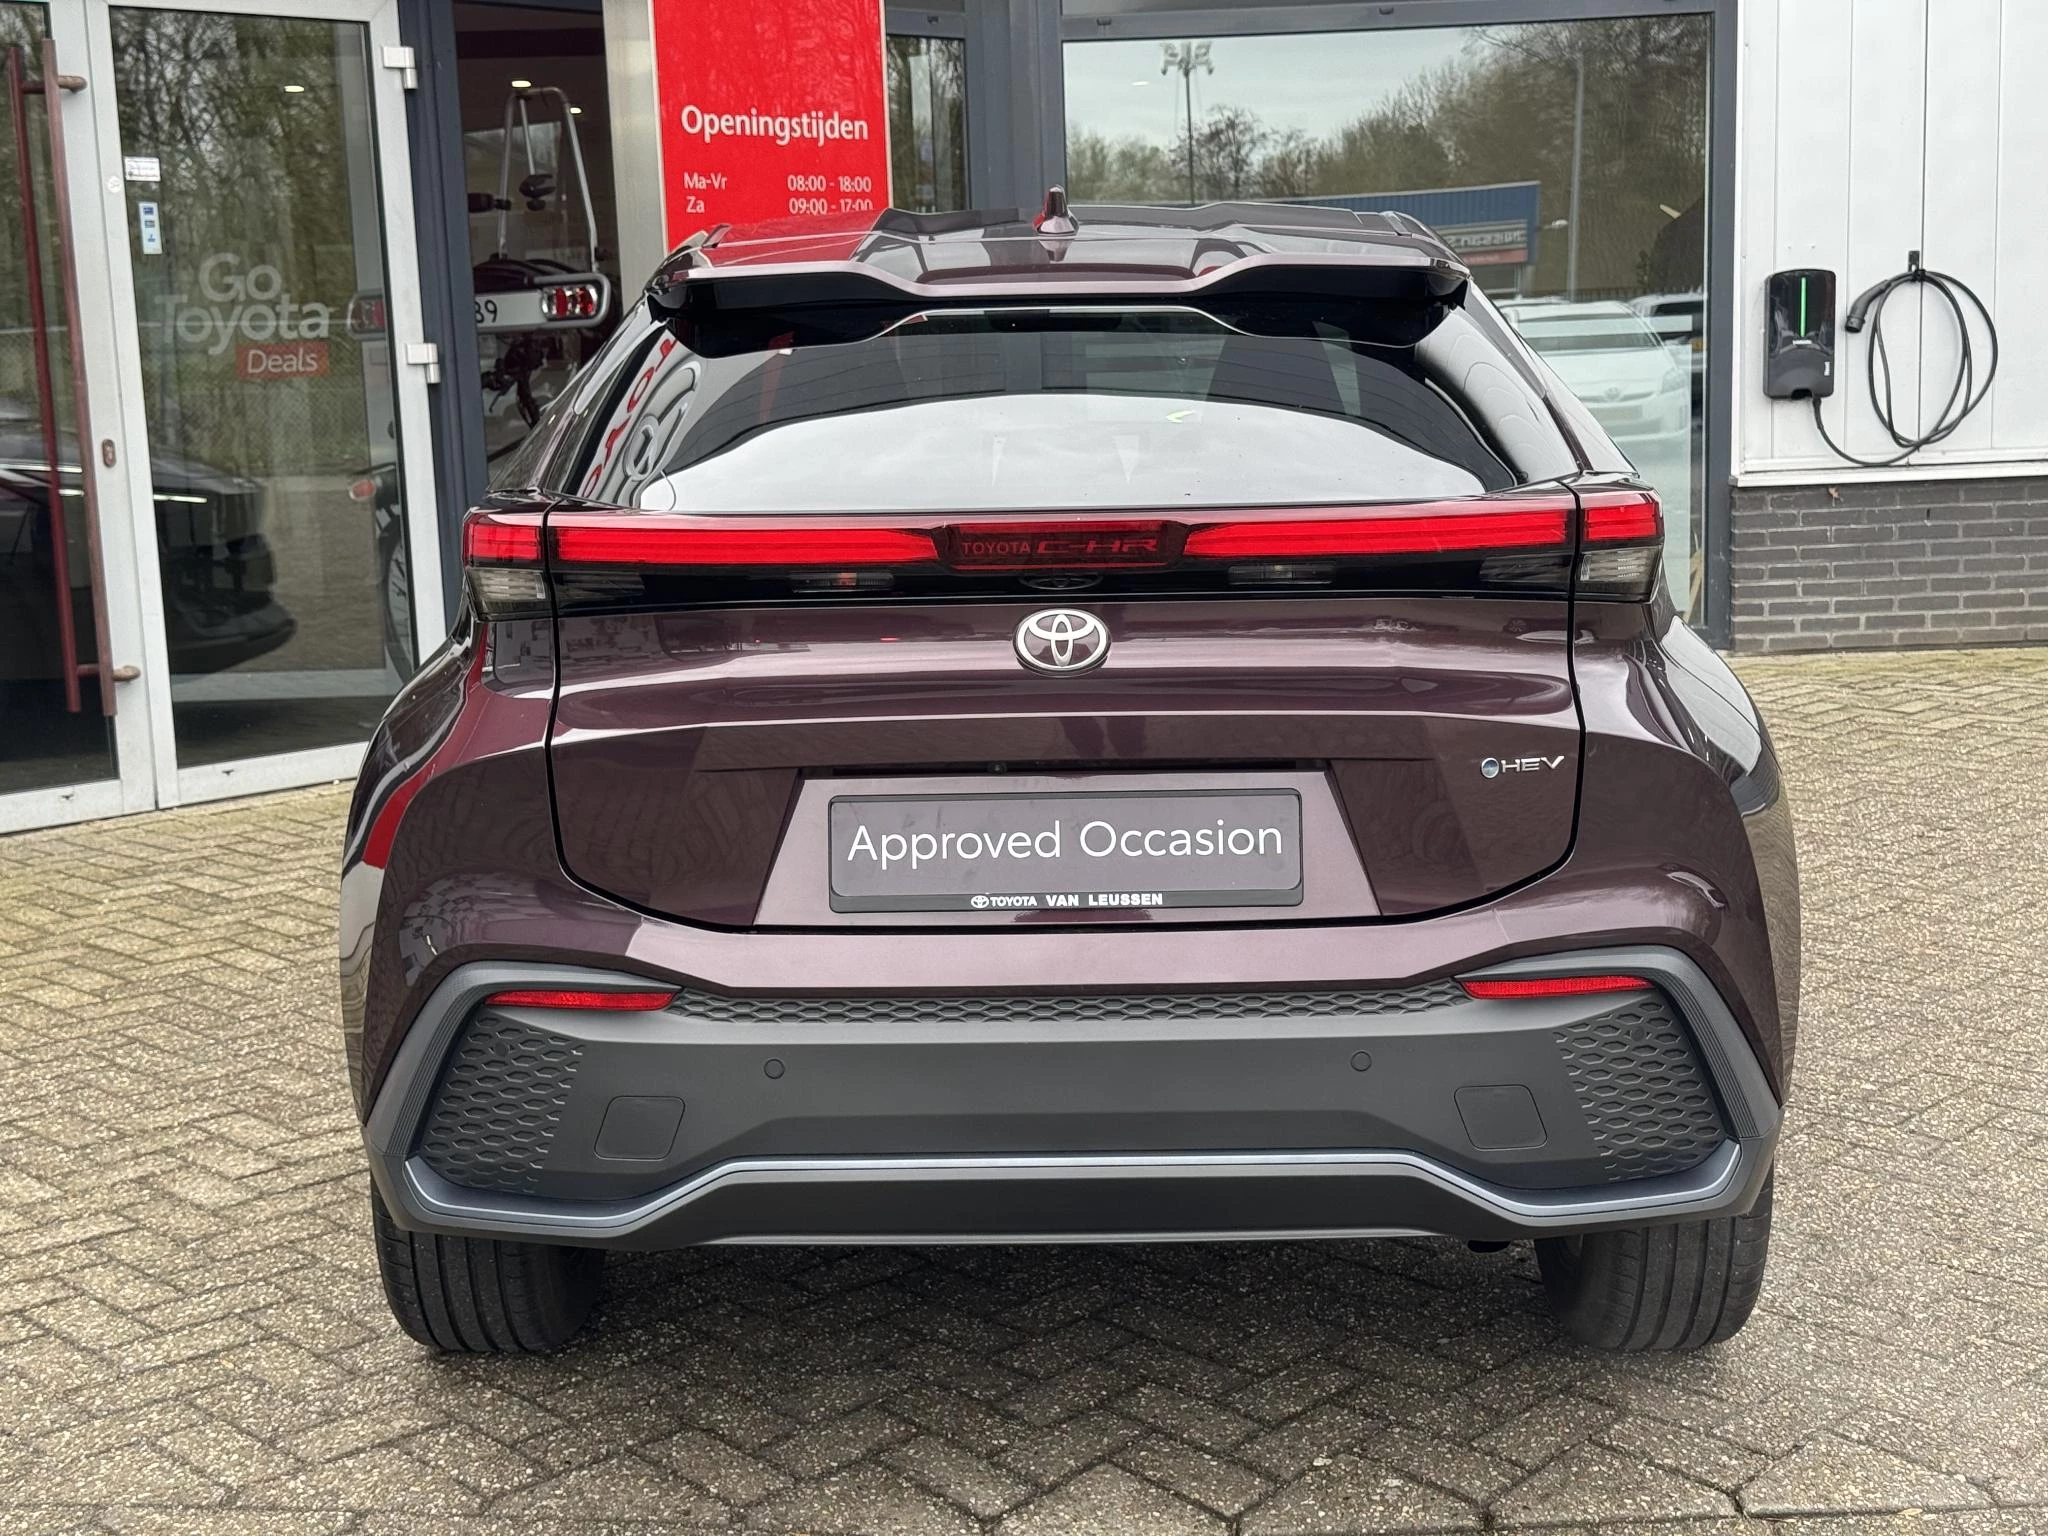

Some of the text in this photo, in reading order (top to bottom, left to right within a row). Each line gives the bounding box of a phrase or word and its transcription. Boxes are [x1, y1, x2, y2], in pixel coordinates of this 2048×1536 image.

[681, 105, 869, 147] Openingstijden
[684, 172, 727, 190] Ma-Vr
[788, 175, 826, 192] 08:00
[838, 176, 872, 193] 18:00
[686, 196, 705, 213] Za
[789, 199, 827, 215] 09:00
[200, 252, 282, 302] Go
[154, 294, 330, 355] Toyota
[247, 348, 318, 373] Deals
[962, 539, 1158, 555] TOYOTA C-HR
[1501, 755, 1565, 773] HEV
[847, 819, 1283, 870] Approved Occasion
[991, 893, 1163, 908] TOYOTA VAN LEUSSEN
